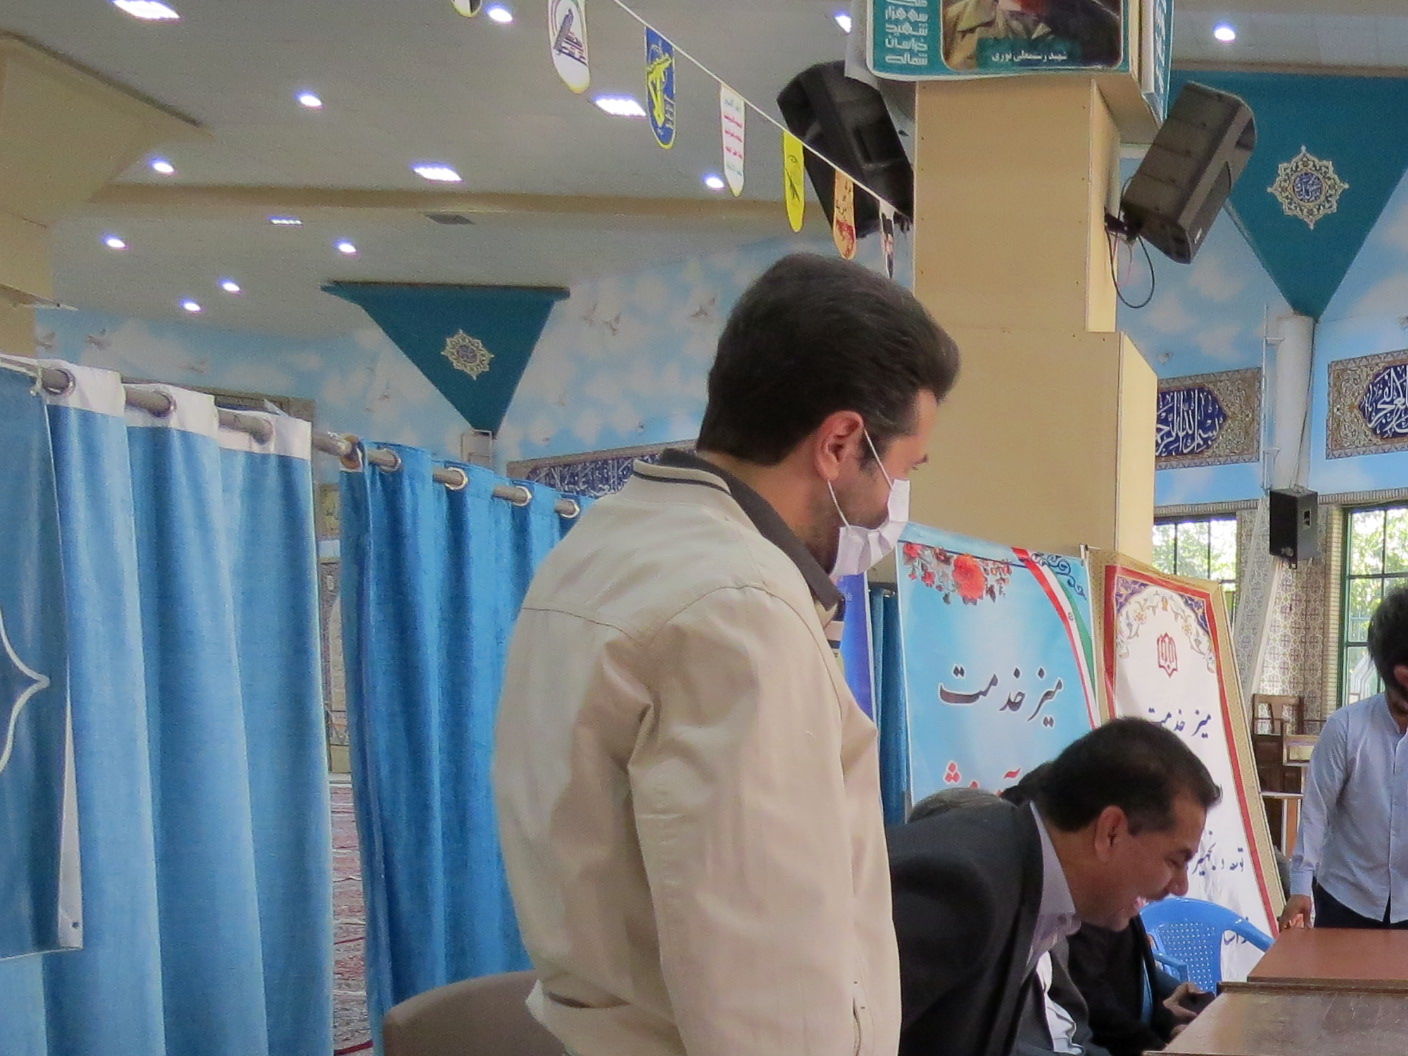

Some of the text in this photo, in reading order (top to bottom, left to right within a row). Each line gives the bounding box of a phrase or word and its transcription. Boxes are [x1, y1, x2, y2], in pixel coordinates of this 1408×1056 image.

[939, 665, 1064, 728] میز خدمت
[1192, 709, 1212, 739] میز
